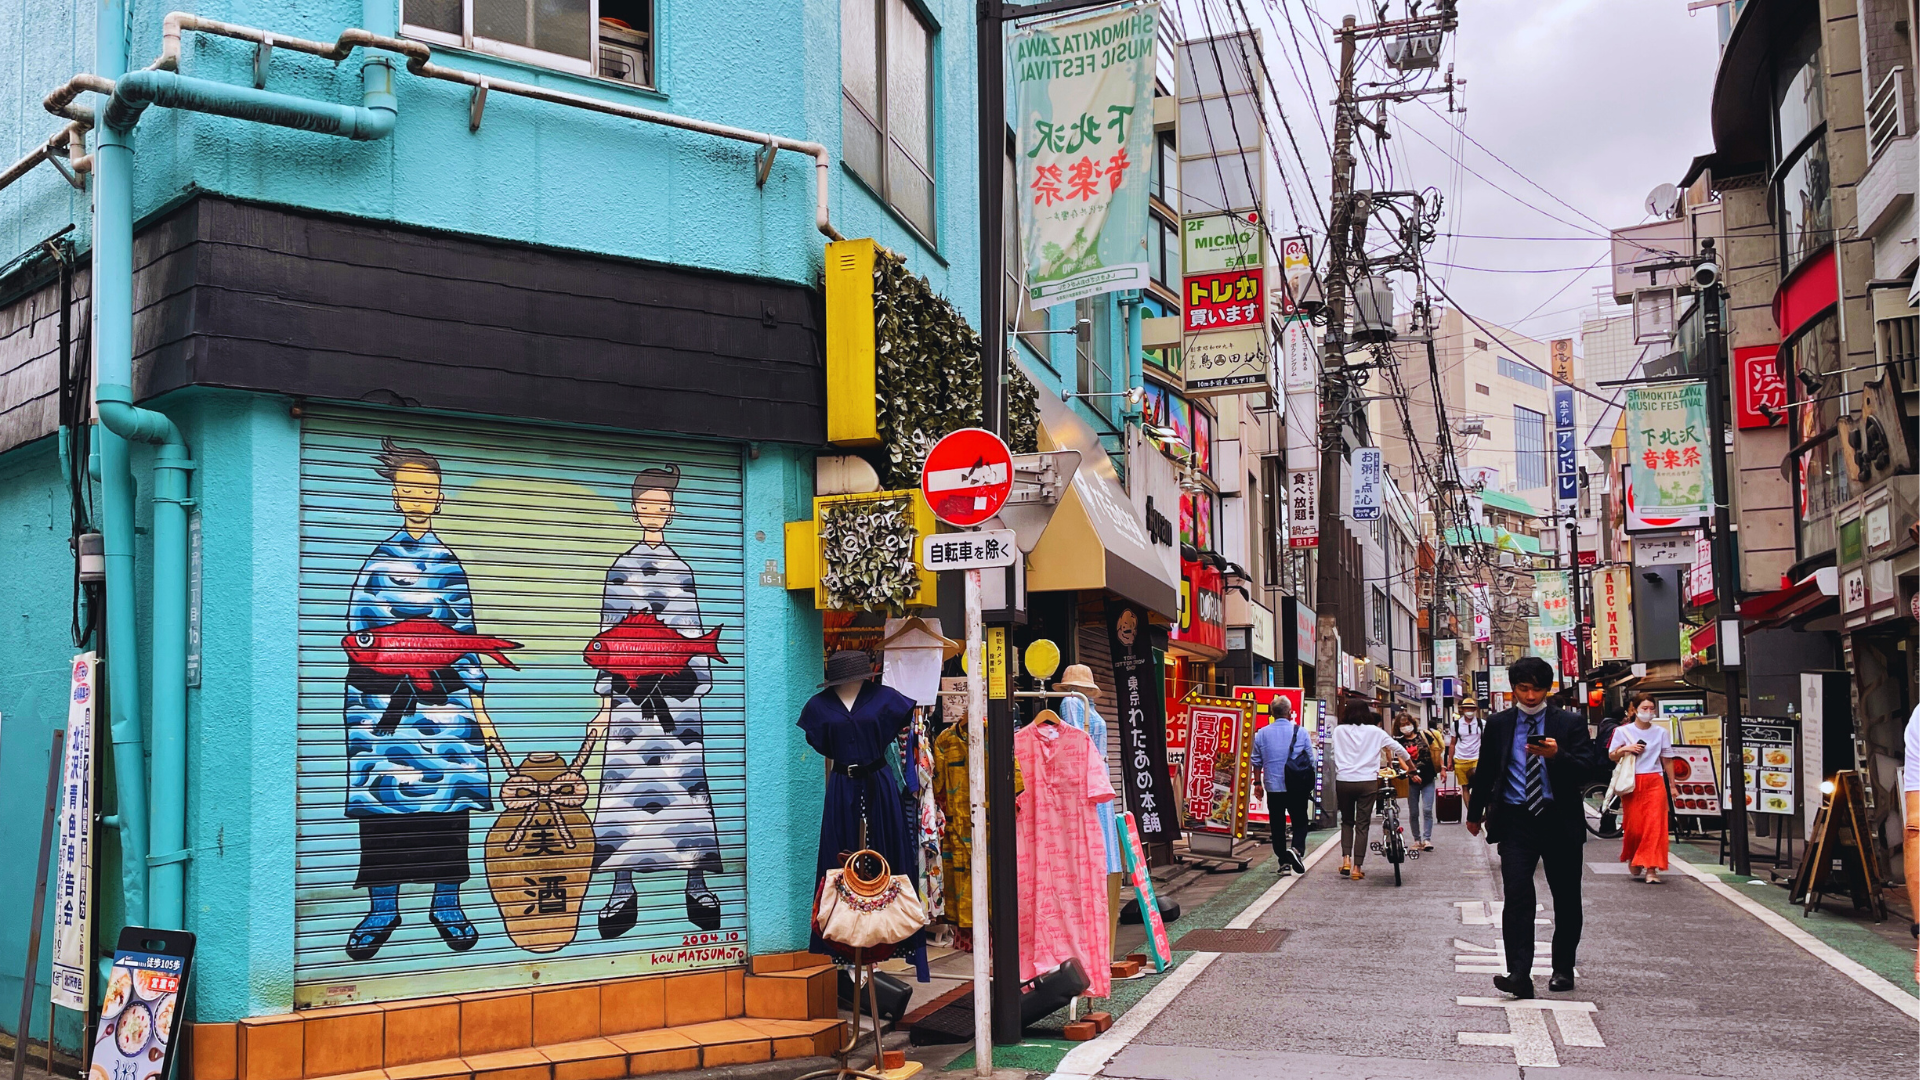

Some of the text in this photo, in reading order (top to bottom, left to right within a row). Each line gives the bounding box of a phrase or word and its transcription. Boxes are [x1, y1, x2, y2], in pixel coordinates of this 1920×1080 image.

[1188, 220, 1205, 232] 2F
[1195, 232, 1250, 249] MICMO
[1190, 276, 1258, 306] トレカ
[1190, 303, 1259, 327] 買います
[1628, 386, 1702, 401] SHIMOKITAZAWA
[1628, 398, 1703, 411] MUSIC FESTIVAL
[1559, 400, 1569, 426] ホテル
[1641, 425, 1702, 447] 下北沢
[1559, 431, 1574, 490] アンドレ
[1642, 446, 1702, 470] 音楽祭
[1361, 452, 1373, 505] お粥と点心
[1293, 473, 1307, 520] 食べ放題
[931, 540, 1010, 564] 自転車を除く
[190, 534, 200, 622] 北沢二丁目
[762, 575, 782, 584] 15-1
[188, 627, 199, 645] 15
[1220, 722, 1231, 749] トレカ
[1127, 676, 1162, 834] 東京わたあめ本舗
[1190, 713, 1219, 820] 買取強化中
[64, 725, 79, 927] 北沢青色申告会
[522, 817, 568, 914] 美酒
[682, 931, 739, 946] 2004.10
[146, 957, 181, 971] 徒歩105歩
[150, 977, 176, 990] 営業中
